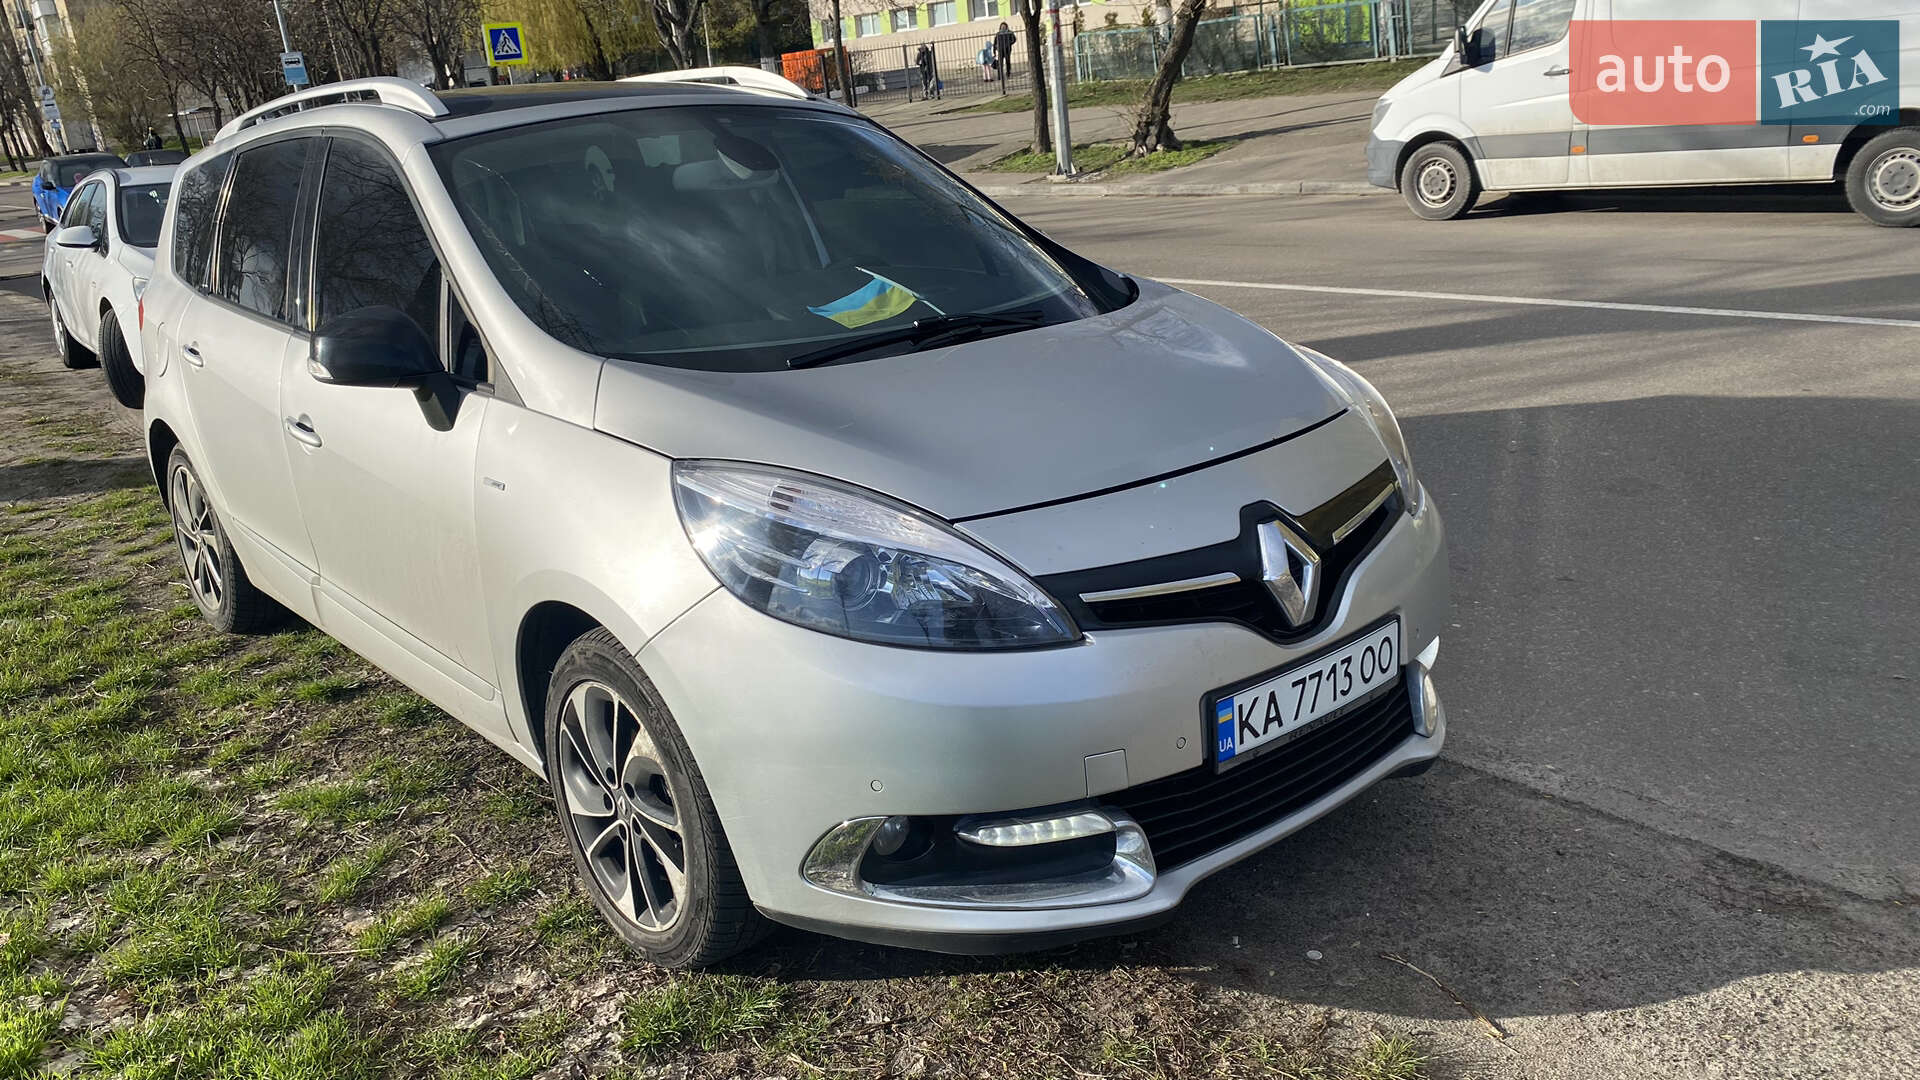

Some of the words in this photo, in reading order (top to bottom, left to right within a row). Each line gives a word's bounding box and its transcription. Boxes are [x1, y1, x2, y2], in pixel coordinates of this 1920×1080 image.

[1238, 690, 1283, 745] KA
[1292, 655, 1353, 721] 7713
[1219, 737, 1233, 753] UA
